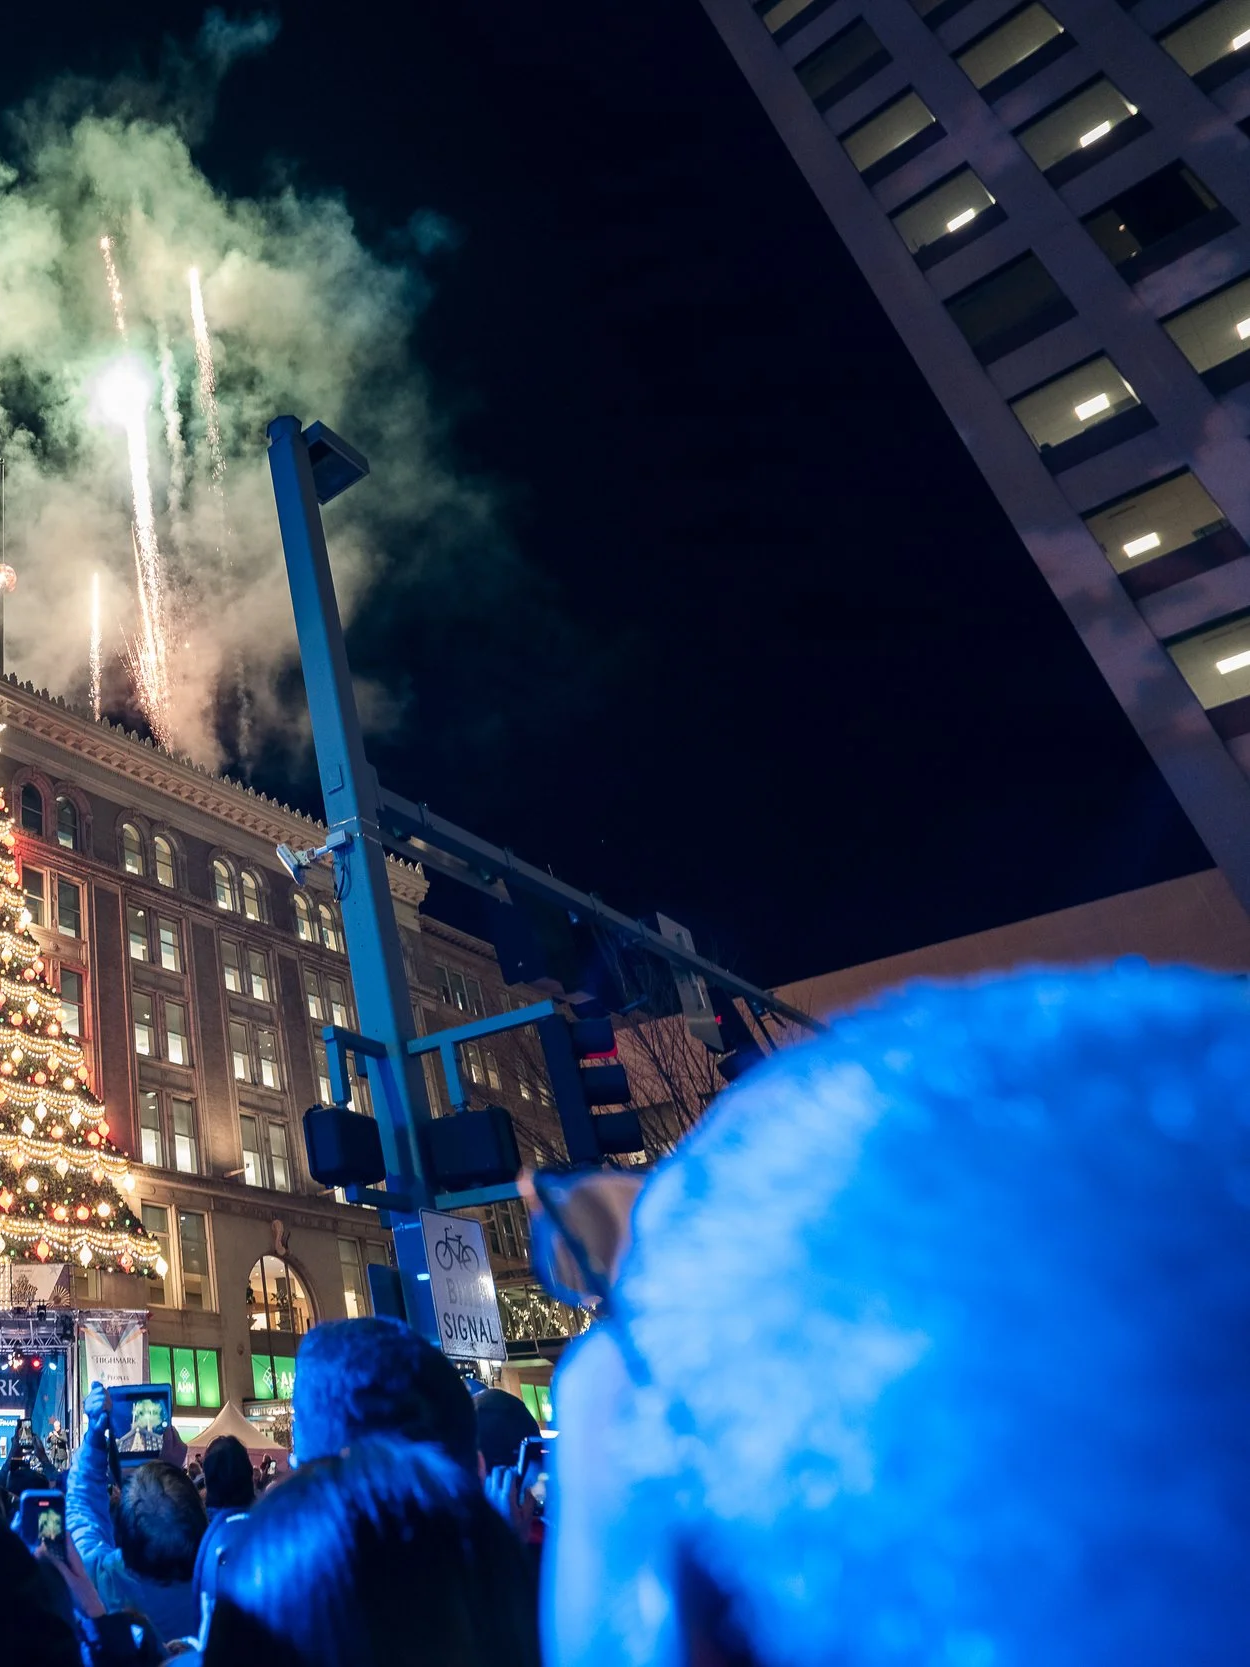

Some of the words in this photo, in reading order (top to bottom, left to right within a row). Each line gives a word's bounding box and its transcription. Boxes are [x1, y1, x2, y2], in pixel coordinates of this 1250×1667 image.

[443, 1312, 498, 1344] SIGNAL
[94, 1356, 137, 1365] HIGHMARK
[280, 1371, 295, 1389] AH
[177, 1382, 195, 1394] AHN
